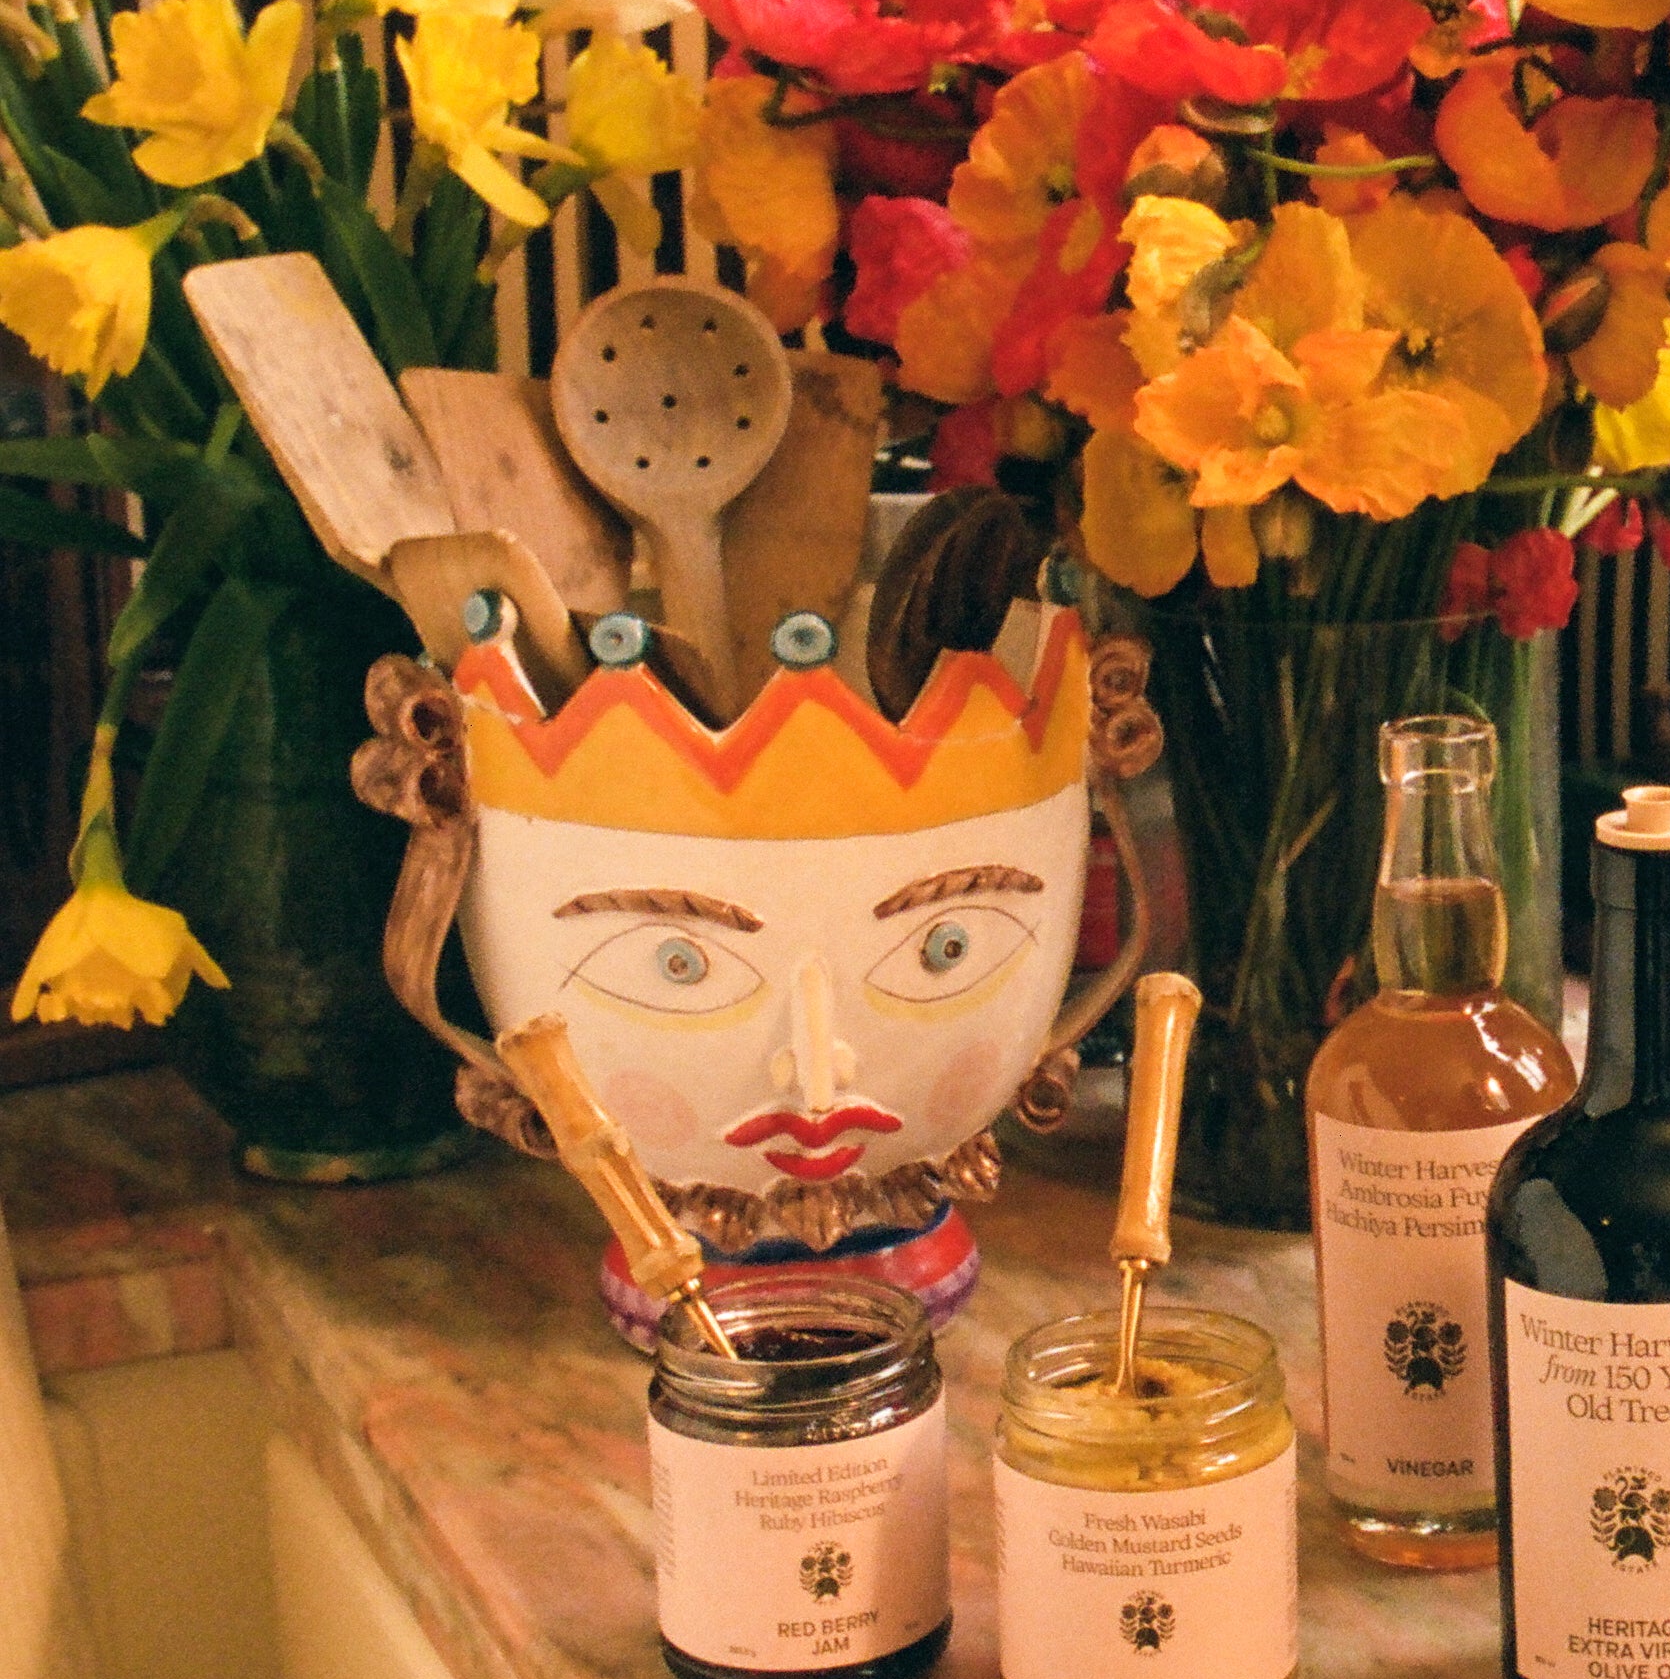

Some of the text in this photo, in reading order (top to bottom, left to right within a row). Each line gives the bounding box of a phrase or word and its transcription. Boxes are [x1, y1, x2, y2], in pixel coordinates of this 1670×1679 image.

[1339, 1148, 1499, 1181] Winter Harves
[1339, 1178, 1488, 1210] Ambrosia Fuy
[1404, 1216, 1486, 1239] Persim
[1519, 1314, 1601, 1356] Winter
[1539, 1354, 1596, 1387] from
[1605, 1365, 1651, 1391] 150
[1566, 1393, 1613, 1421] Old
[751, 1458, 888, 1488] Limited Edition
[1387, 1457, 1474, 1477] VINEGAR
[735, 1472, 906, 1512] Heritage Raspberry
[760, 1502, 886, 1533] Ruby Hibiscus
[1083, 1508, 1207, 1532] Fresh Wasabi
[1048, 1523, 1243, 1555] Golden Mustard Seeds
[1061, 1549, 1232, 1577] Hawaiian Turmeric
[777, 1621, 816, 1639] RED
[822, 1610, 880, 1634] BERRY
[812, 1635, 850, 1656] JAM
[1568, 1634, 1634, 1660] EXTRA
